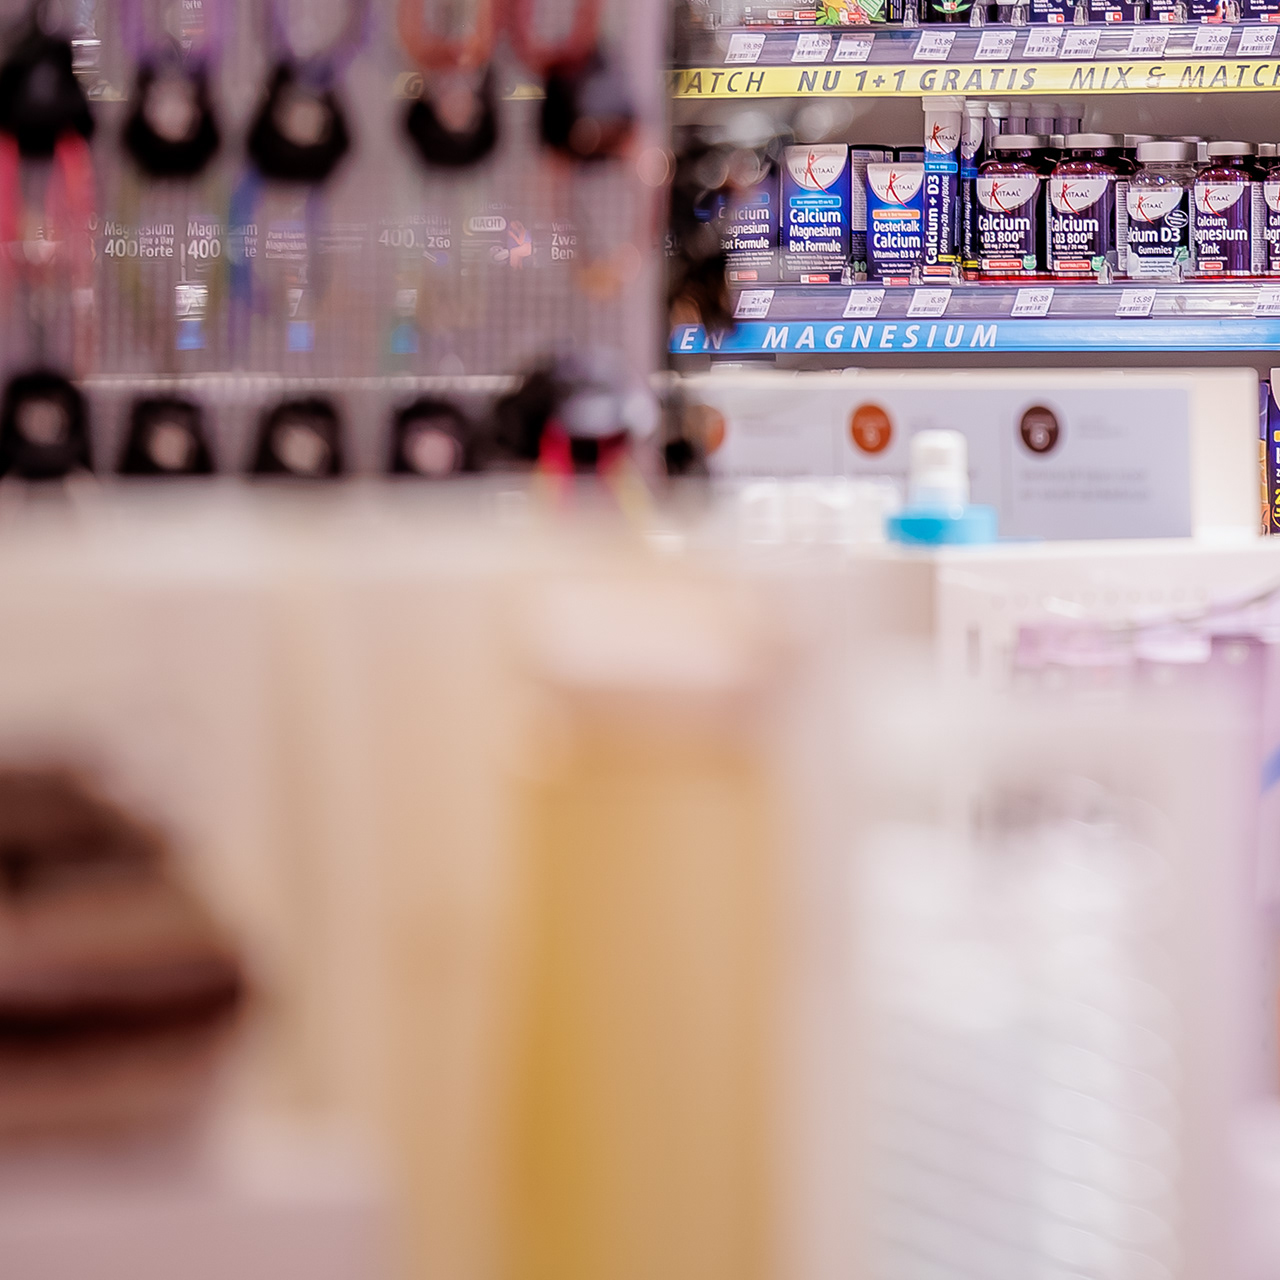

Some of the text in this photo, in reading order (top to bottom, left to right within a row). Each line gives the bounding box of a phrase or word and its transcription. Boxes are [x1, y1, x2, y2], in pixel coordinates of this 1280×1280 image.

[798, 70, 841, 92] NU
[855, 69, 906, 93] 1+1
[919, 68, 1038, 92] GRATIS
[1069, 65, 1134, 90] MIX
[789, 208, 841, 223] Calcium
[789, 224, 841, 238] Magnesium
[789, 240, 841, 252] Bot Formule
[762, 324, 998, 349] MAGNESIUM
